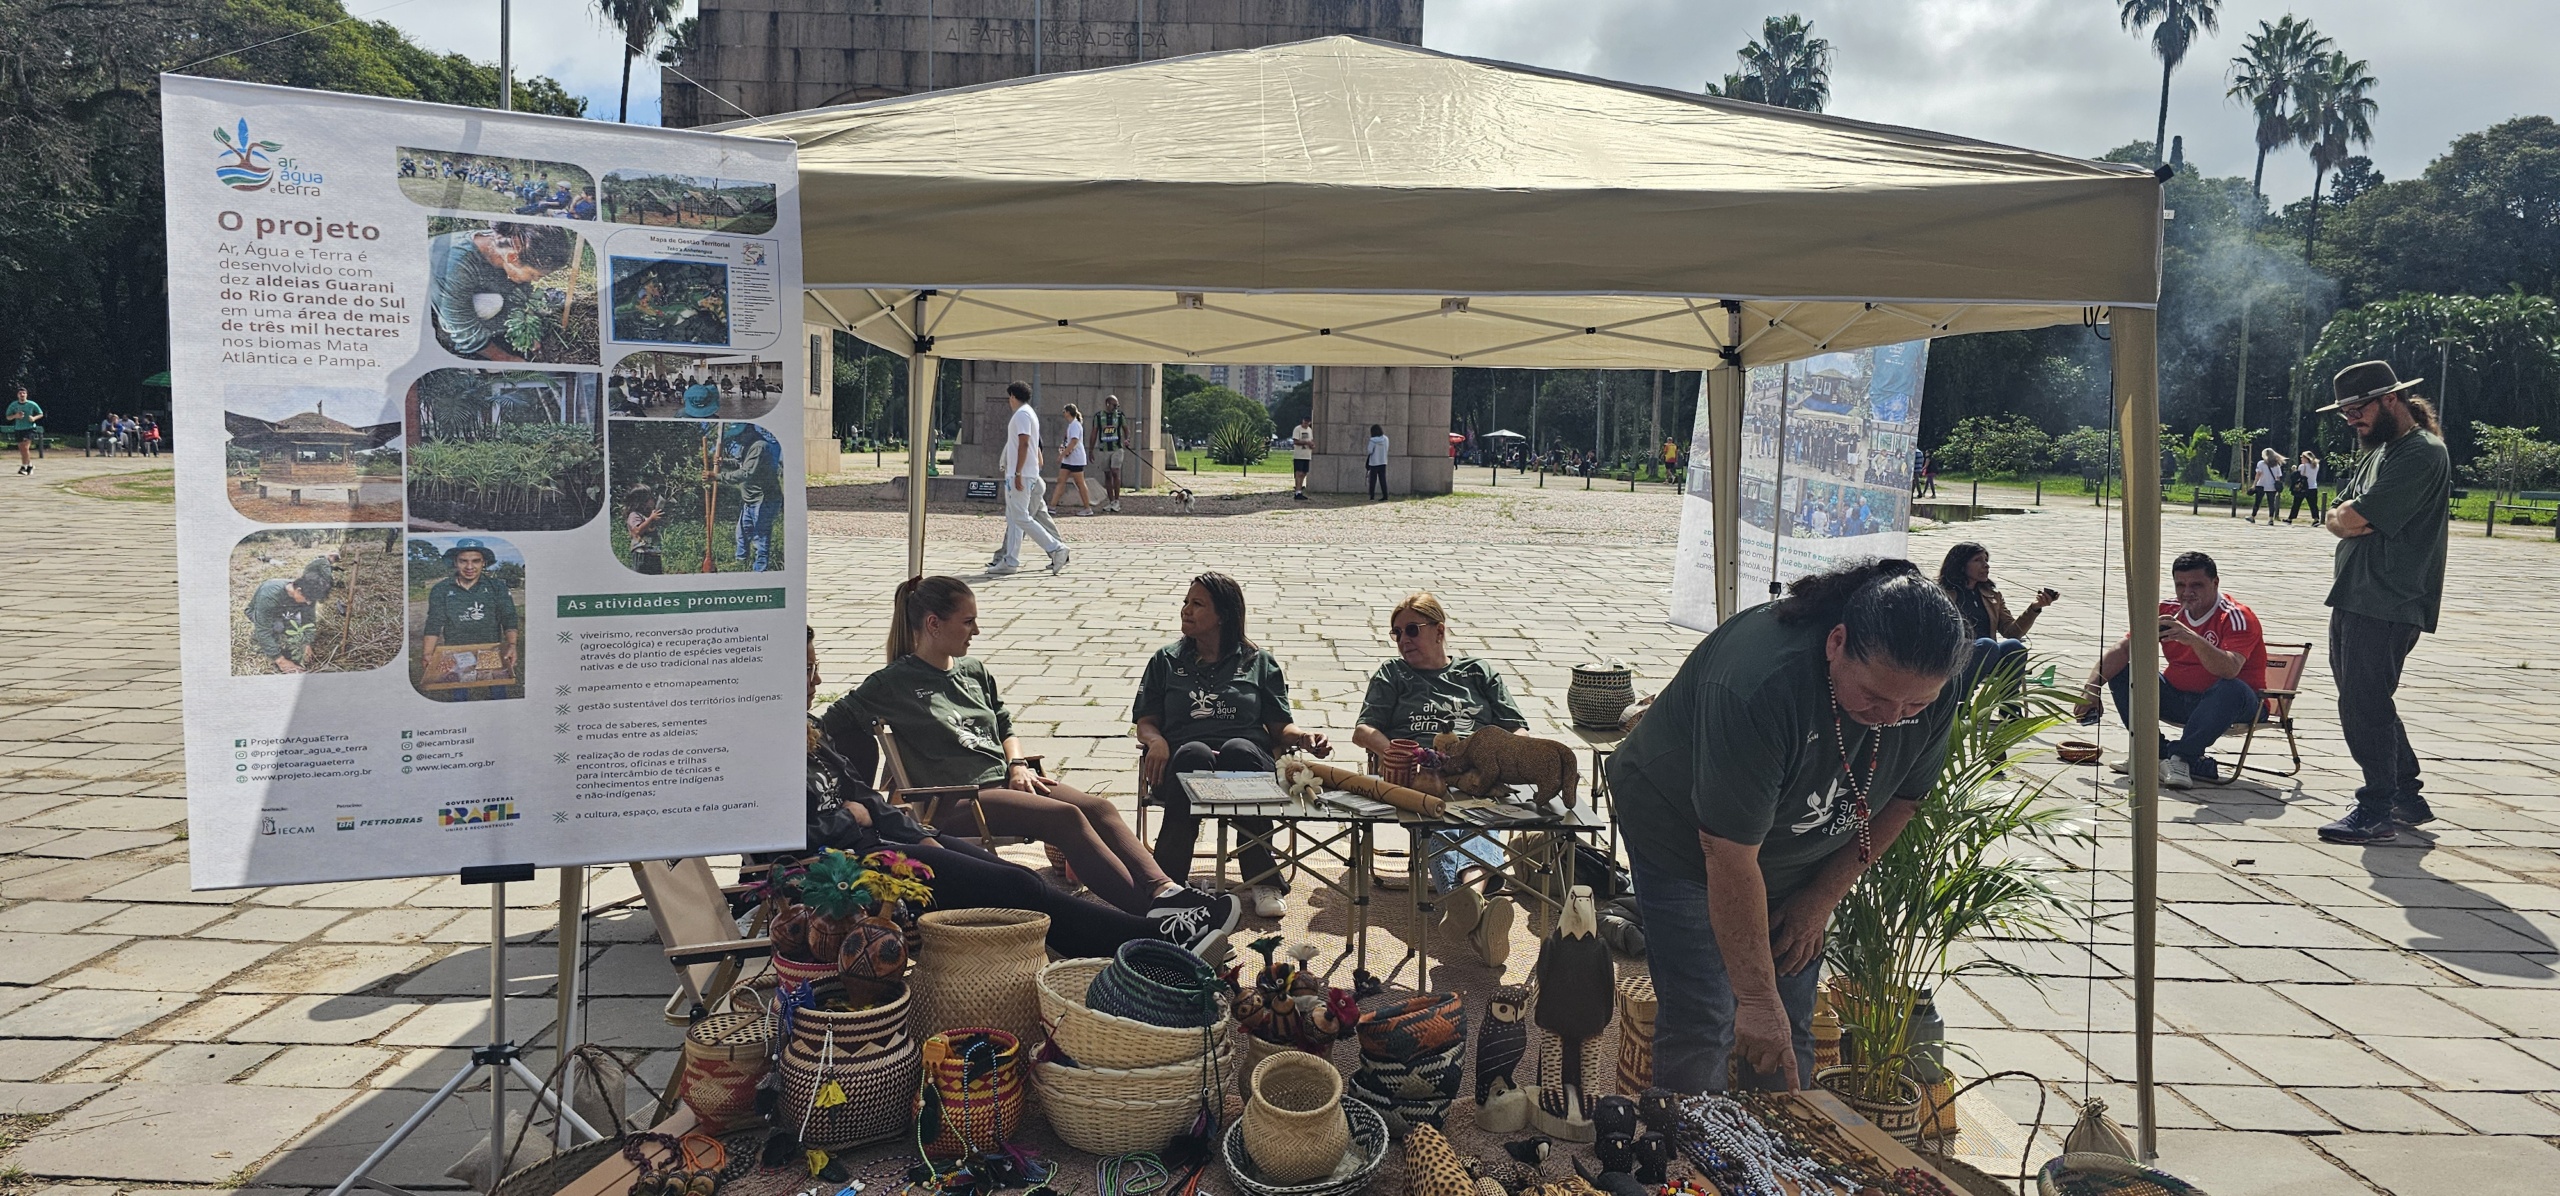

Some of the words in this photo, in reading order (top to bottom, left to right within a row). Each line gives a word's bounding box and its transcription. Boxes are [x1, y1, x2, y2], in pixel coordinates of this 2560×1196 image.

[278, 157, 298, 169] ar,
[280, 167, 323, 185] água
[278, 181, 320, 197] terra
[218, 210, 243, 231] O
[256, 217, 380, 243] projeto
[218, 242, 239, 256] Ar,
[244, 241, 289, 260] Água
[295, 249, 304, 259] e
[310, 248, 352, 261] Terra
[358, 251, 367, 262] é
[701, 240, 730, 248] Territorial
[219, 258, 333, 276] desenvolvido
[338, 267, 373, 278] com
[220, 273, 250, 285] dez
[256, 274, 320, 289] aldeias
[325, 279, 394, 294] Guarani
[220, 288, 242, 300] do
[249, 290, 277, 302] Rio
[283, 292, 348, 306] Grande
[353, 294, 374, 307] do
[380, 297, 405, 309] Sul
[221, 307, 247, 317] em
[254, 308, 292, 319] uma
[298, 307, 337, 321] área
[343, 309, 364, 322] de
[370, 312, 410, 324] mais
[221, 319, 243, 331] de
[249, 321, 285, 333] três
[291, 323, 318, 335] mil
[325, 323, 400, 338] hectares
[222, 337, 253, 348] nos
[259, 336, 321, 350] biomas
[327, 340, 368, 352] Mata
[222, 351, 297, 365] Atlântica
[304, 355, 313, 365] e
[319, 355, 381, 370] Pampa.
[567, 599, 587, 610] As
[594, 597, 680, 609] atividades
[688, 594, 773, 609] promovem:
[580, 629, 633, 640] viveirismo,
[635, 627, 693, 638] reconversão
[696, 626, 739, 637] produtiva
[580, 640, 655, 651] (agroecológica)
[665, 636, 723, 648] recuperação
[724, 634, 769, 643] ambiental
[580, 651, 616, 661] através
[618, 650, 631, 660] do
[633, 648, 667, 659] plantio
[669, 648, 681, 657] de
[683, 646, 723, 657] espécies
[724, 645, 762, 655] vegetais
[580, 662, 615, 672] nativas
[617, 662, 624, 670] e
[626, 660, 638, 669] de
[641, 661, 658, 669] uso
[660, 657, 709, 668] tradicional
[712, 657, 728, 665] nas
[730, 655, 764, 664] aldeias;
[577, 682, 643, 694] mapeamento
[654, 677, 739, 689] etnomapeamento;
[577, 702, 611, 713] gestão
[613, 699, 668, 709] sustentável
[670, 698, 688, 708] dos
[690, 695, 736, 706] territórios
[1423, 702, 1437, 713] ar,
[417, 727, 467, 736] iecambrasil
[577, 722, 602, 731] troca
[605, 720, 617, 730] de
[619, 719, 660, 730] saberes,
[662, 718, 707, 727] sementes
[251, 735, 349, 747] ProjetoArAguaETerra
[586, 731, 618, 740] mudas
[622, 731, 647, 739] entre
[663, 728, 698, 738] aldeias;
[416, 738, 474, 748] @iecambrasil
[251, 745, 368, 758] @projetoar_agua_e_terra
[416, 751, 463, 760] @iecam_rs
[576, 751, 625, 760] realização
[628, 750, 640, 758] de
[642, 748, 669, 758] rodas
[672, 747, 684, 756] de
[686, 746, 729, 755] conversa,
[251, 759, 355, 771] @projetoaraguaeterra
[416, 760, 495, 772] www.iecam.org.br
[576, 760, 628, 770] encontros,
[630, 757, 667, 767] oficinas
[678, 756, 707, 765] trilhas
[251, 769, 372, 781] www.projeto.iecam.org.br
[576, 772, 598, 782] para
[601, 768, 658, 779] intercâmbio
[661, 767, 673, 776] de
[675, 765, 712, 775] técnicas
[576, 779, 650, 790] conhecimentos
[652, 777, 678, 786] entre
[680, 774, 724, 785] indígenas
[584, 789, 656, 799] não-indígenas;
[438, 802, 520, 827] BRASIL
[584, 809, 621, 819] cultura,
[622, 807, 659, 817] espaço,
[662, 805, 692, 814] escuta
[702, 802, 719, 811] fala
[722, 801, 759, 812] guarani.
[360, 817, 423, 827] PETROBRAS
[470, 822, 514, 830] RECONSTRUÇÃO
[278, 826, 315, 835] IECAM
